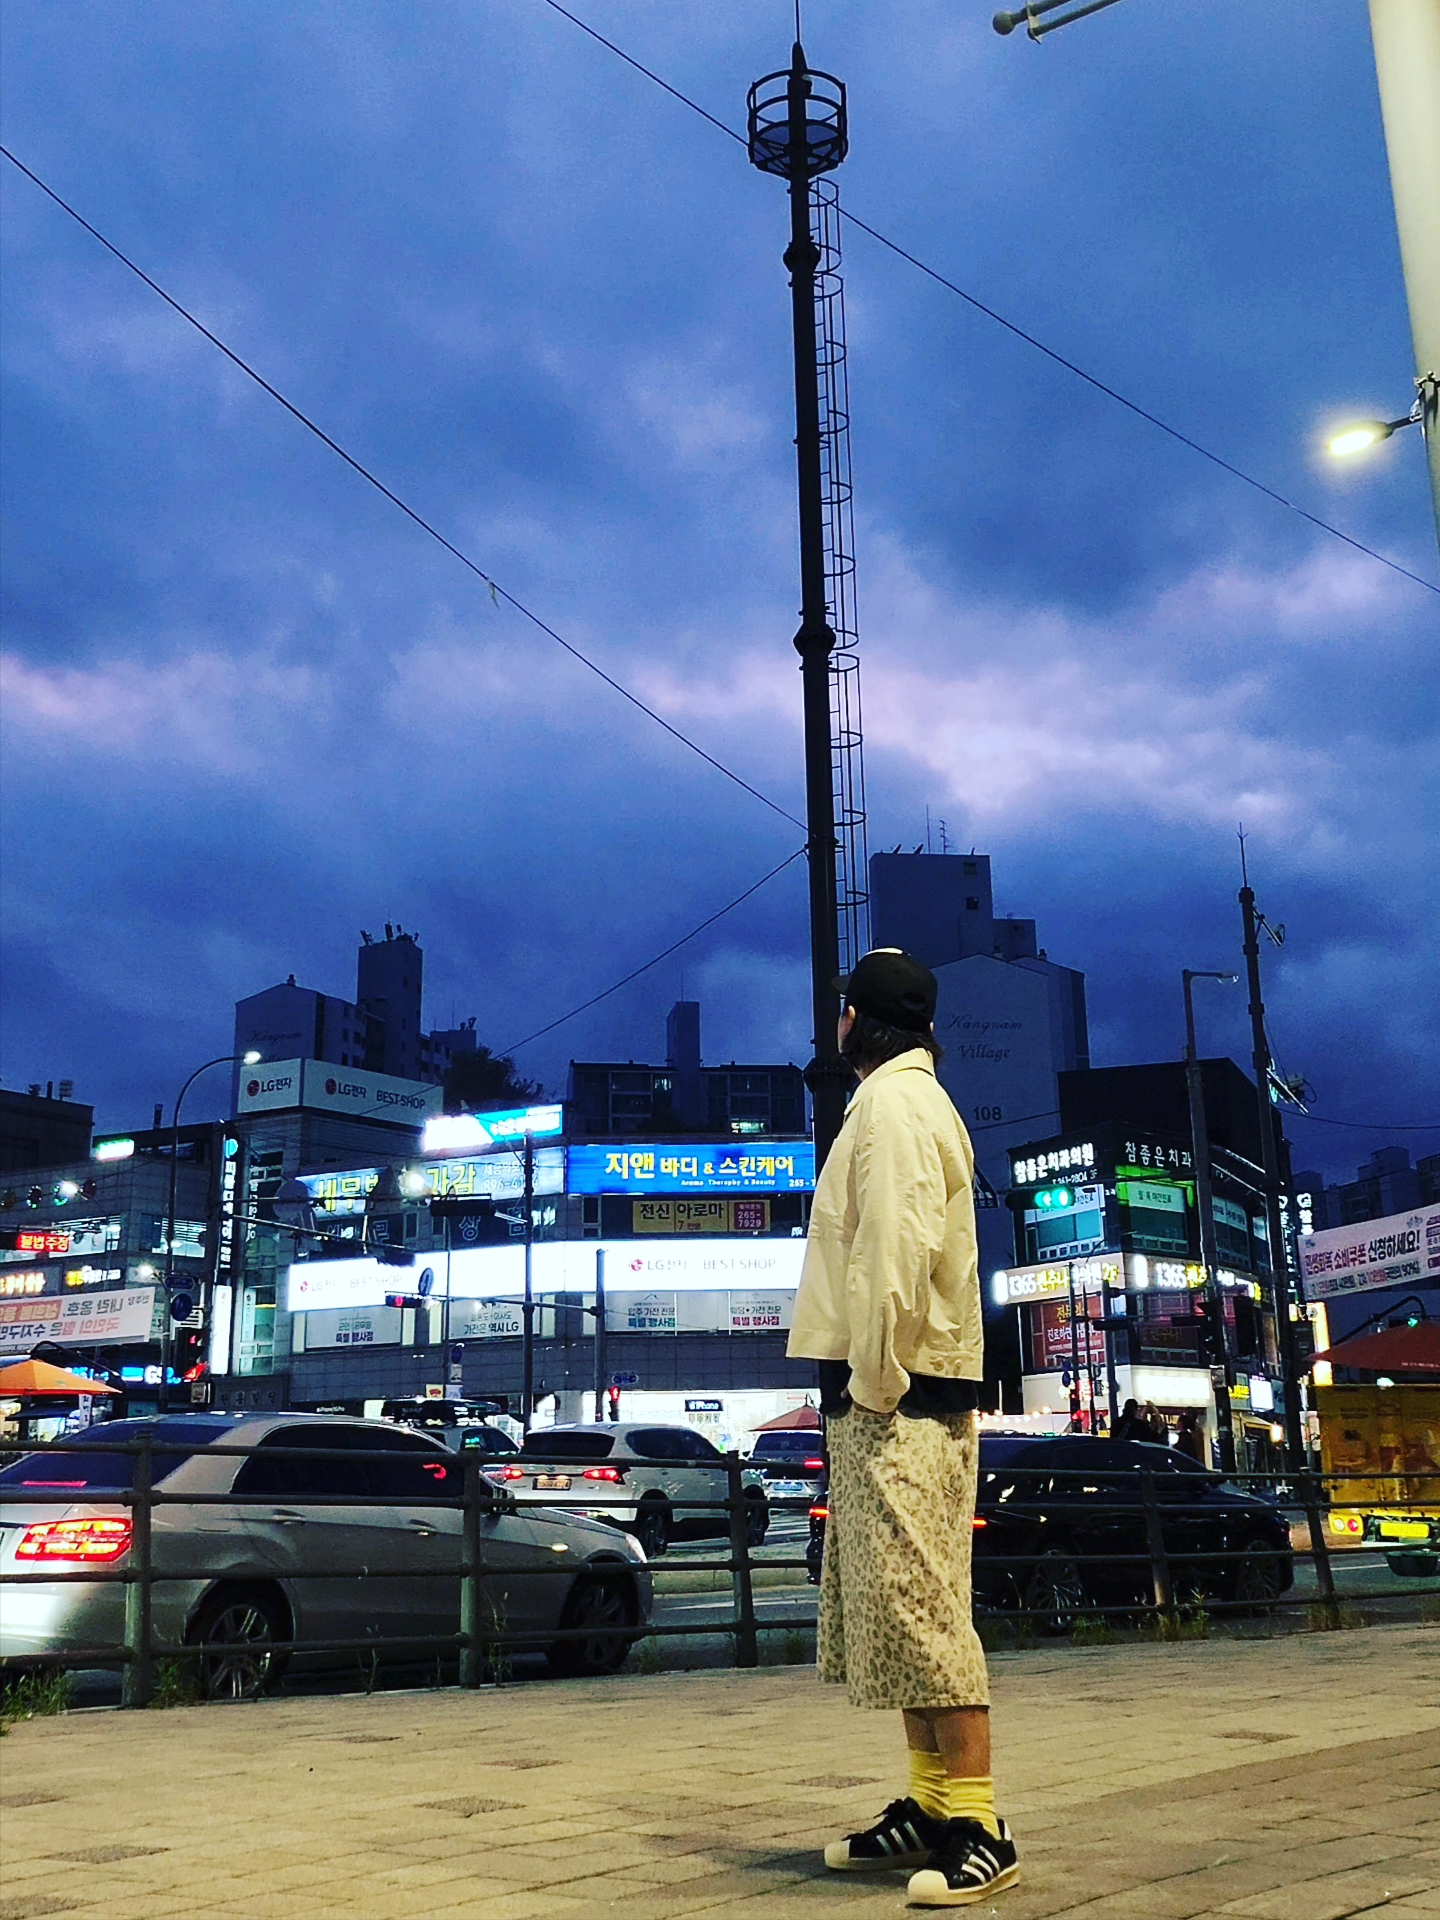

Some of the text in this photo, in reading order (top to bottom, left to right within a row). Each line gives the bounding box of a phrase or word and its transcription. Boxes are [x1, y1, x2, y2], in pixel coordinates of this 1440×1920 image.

[947, 1014, 1022, 1035] Kangnam
[957, 1044, 1011, 1062] Village
[261, 1077, 292, 1092] LG전자
[338, 1082, 426, 1110] LG전자 BEST SHOP
[973, 1106, 1002, 1121] 108
[605, 1152, 794, 1180] 지앤 바디 & 스킨케어
[484, 1177, 539, 1193] 896-414
[639, 1202, 725, 1219] 전신 아로마
[739, 1258, 777, 1269] SHOP
[506, 1321, 519, 1332] LG
